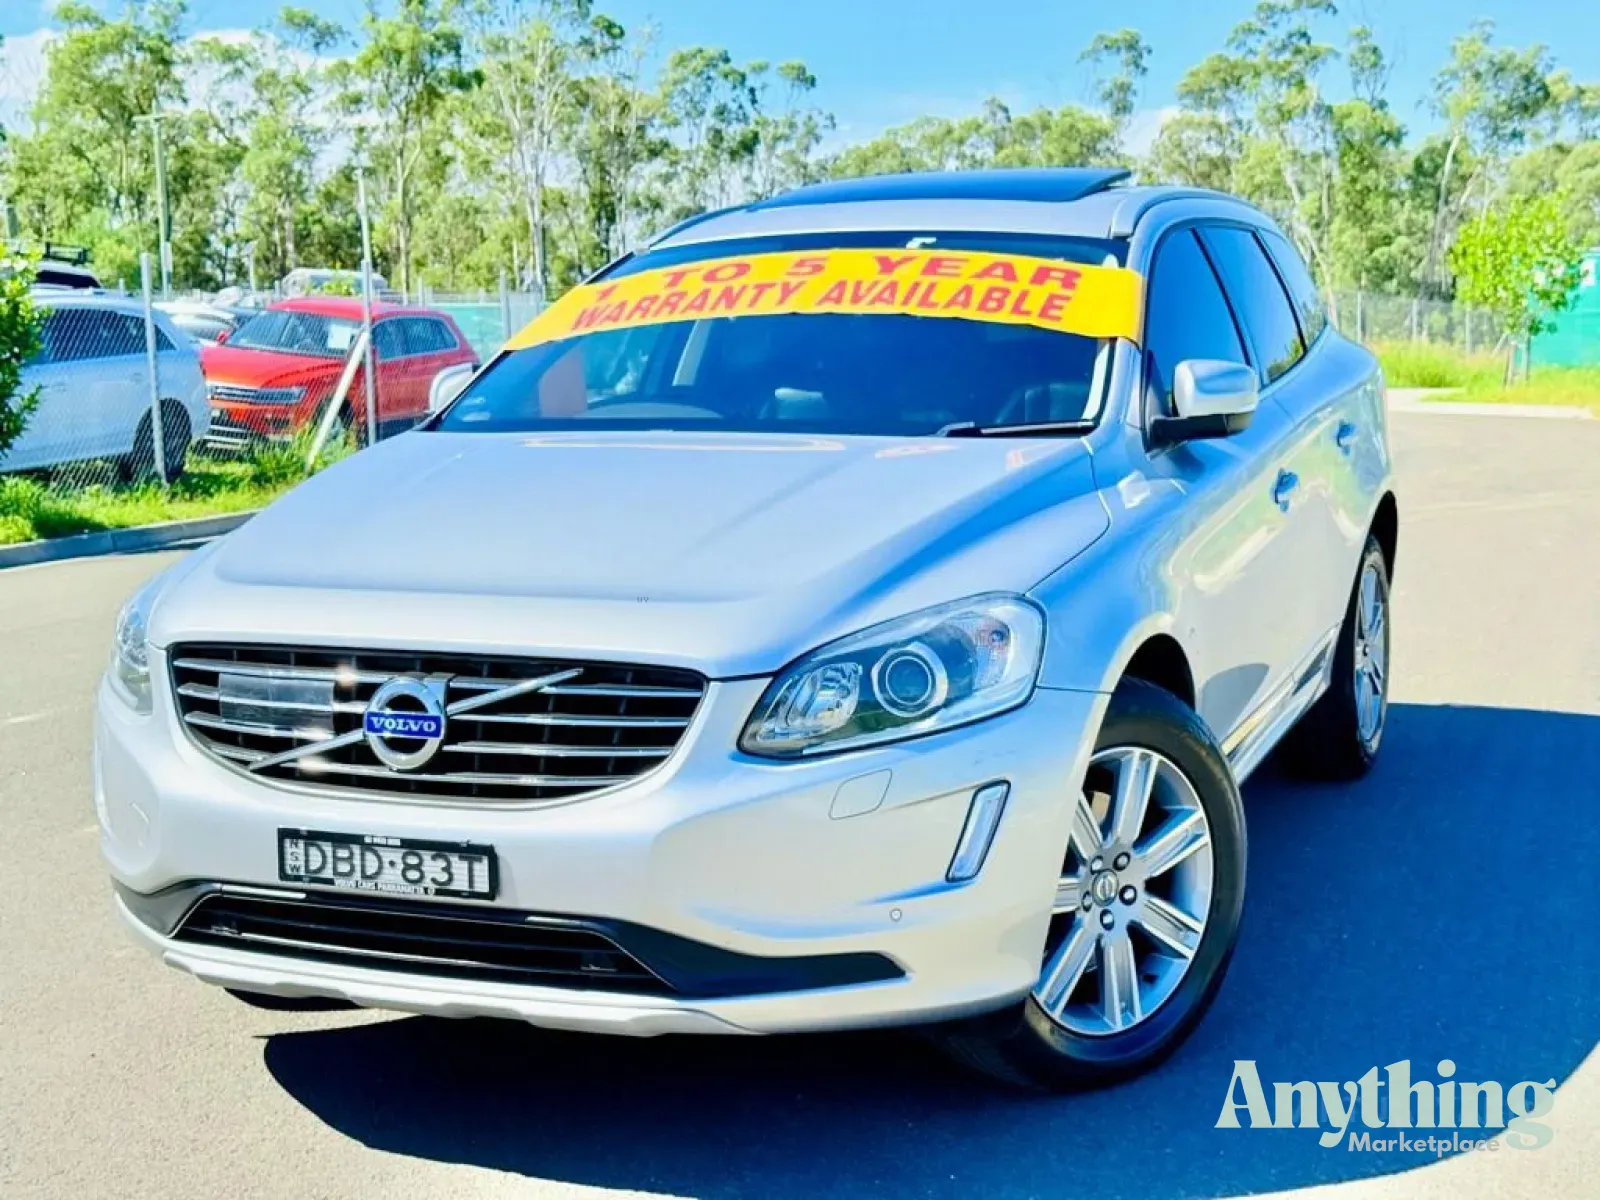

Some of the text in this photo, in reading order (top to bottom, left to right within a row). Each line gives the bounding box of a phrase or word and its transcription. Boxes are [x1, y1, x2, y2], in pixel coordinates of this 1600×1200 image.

[597, 256, 1082, 300] 1 TO 5 YEAR
[571, 280, 1073, 330] WARRANTY AVAILABLE
[370, 717, 437, 732] VOLVO
